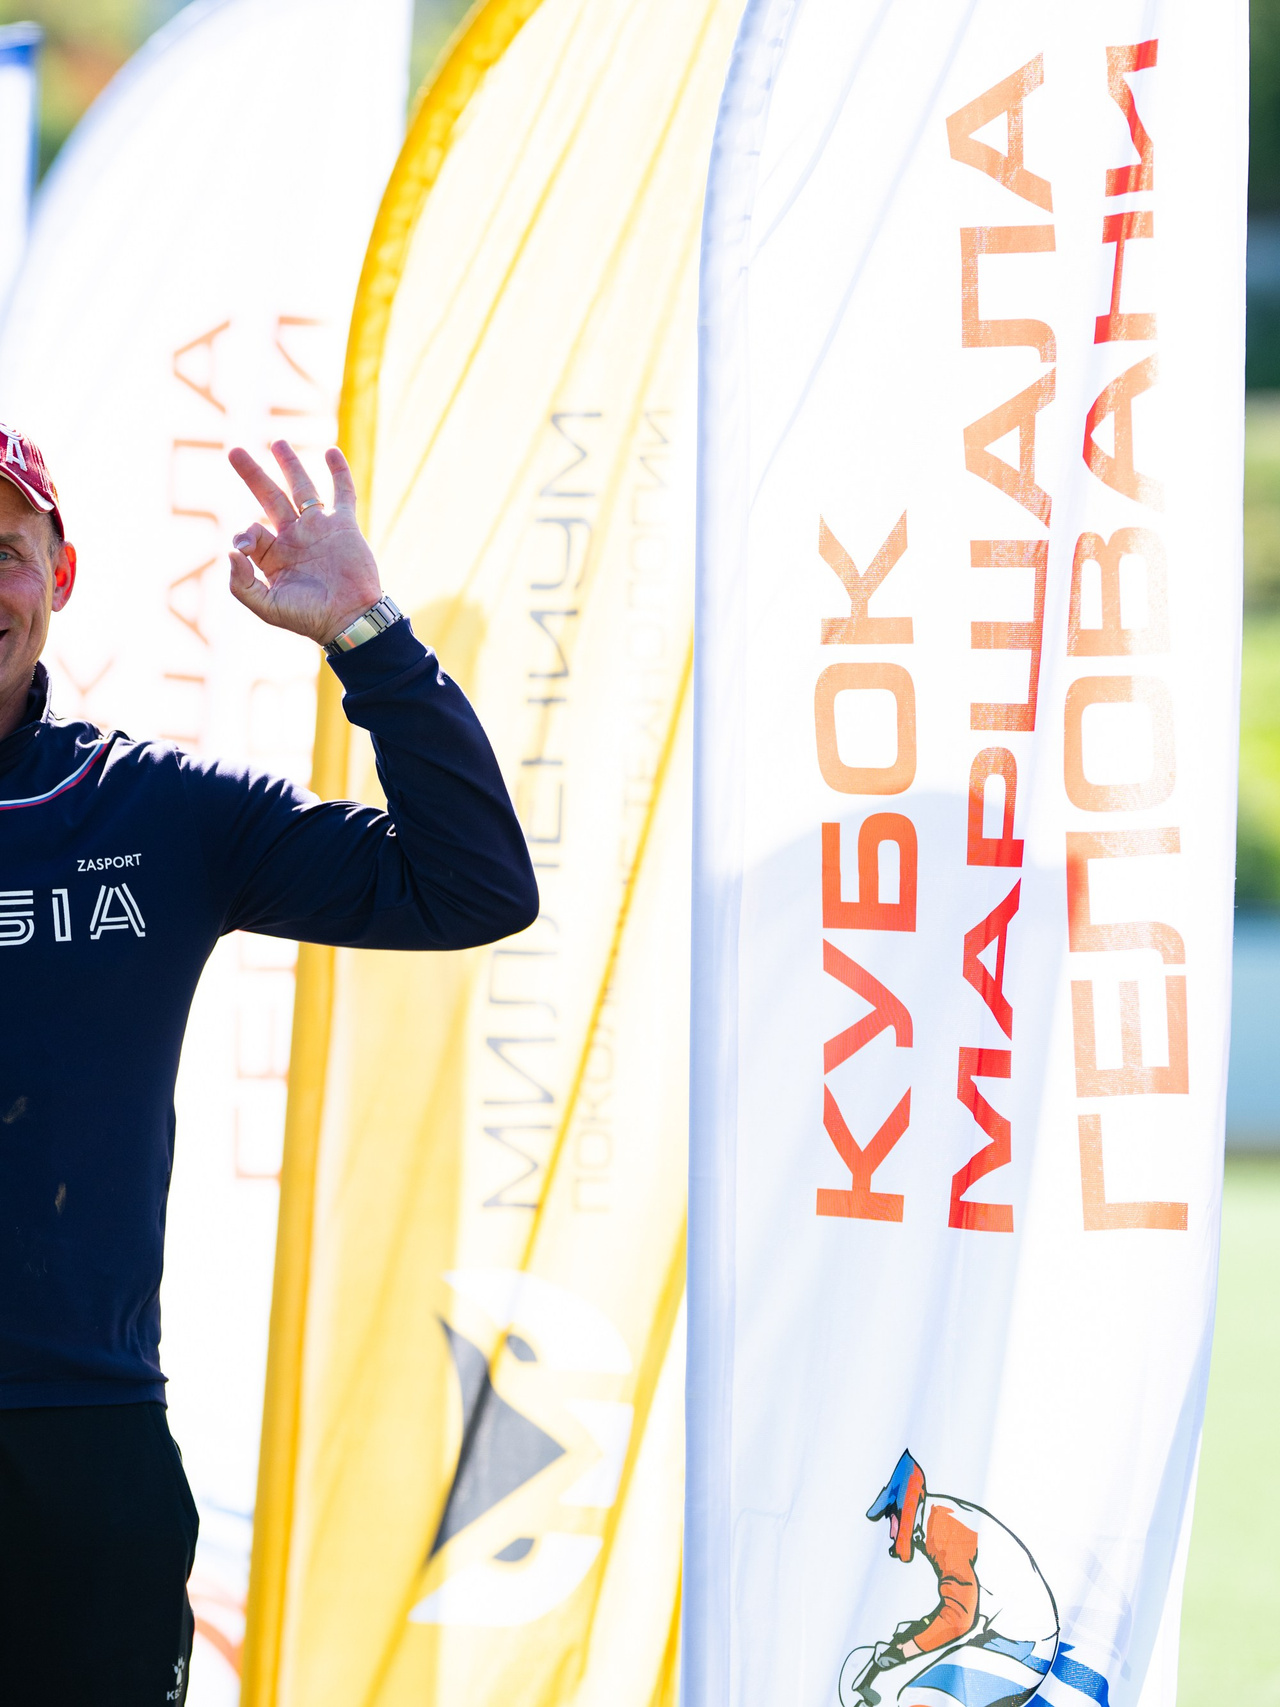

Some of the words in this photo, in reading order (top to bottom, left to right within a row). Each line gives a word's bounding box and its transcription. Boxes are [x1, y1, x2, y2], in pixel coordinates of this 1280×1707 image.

[77, 853, 142, 872] ZASPORT
[814, 509, 918, 1223] КУБОК
[945, 50, 1057, 1233] МАРШАЛА
[1063, 38, 1190, 1231] ГЕЛОВАНИ
